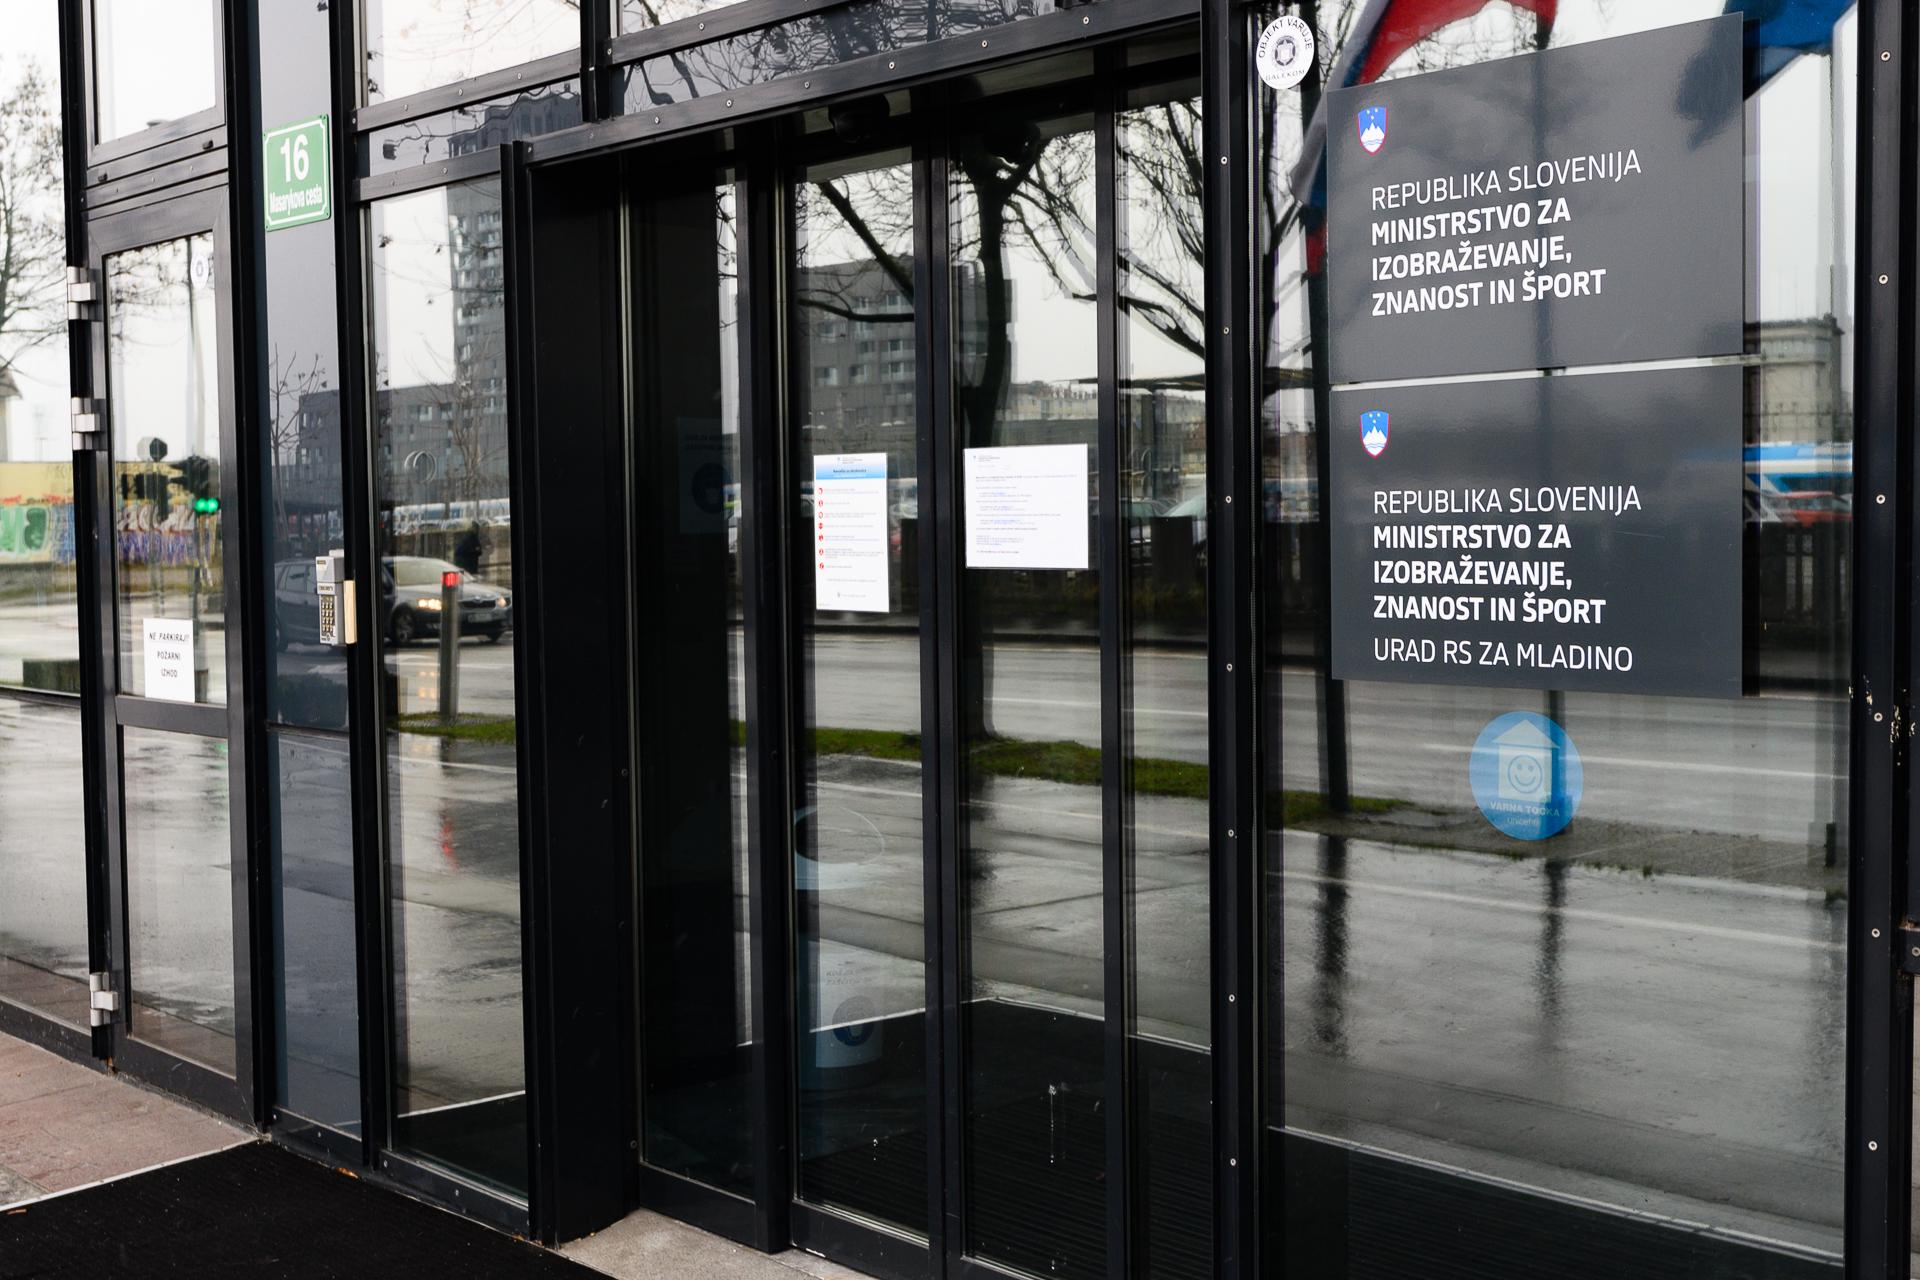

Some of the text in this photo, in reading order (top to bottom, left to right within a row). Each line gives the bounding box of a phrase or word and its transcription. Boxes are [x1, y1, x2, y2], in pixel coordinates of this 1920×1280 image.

[1258, 18, 1312, 58] OBJEKT VARUJE
[280, 134, 309, 183] 16
[306, 184, 323, 206] cesta
[1372, 149, 1642, 211] REPUBLIKA SLOVENIJA
[1371, 198, 1572, 246] MINISTRSTVO ZA
[1372, 236, 1572, 281] IZOBRAŽEVANJE,
[1371, 269, 1607, 317] ZNANOST IN ŠPORT
[1374, 485, 1642, 517] REPUBLIKA SLOVENIJA
[1373, 524, 1572, 549] MINISTRSTVO ZA
[1374, 555, 1573, 592] IZOBRAŽEVANJE,
[1373, 592, 1607, 624] ZNANOST IN ŠPORT
[149, 632, 156, 641] NE
[1374, 638, 1633, 672] URAD RS ZA MLADINO
[1489, 801, 1523, 813] VARNA
